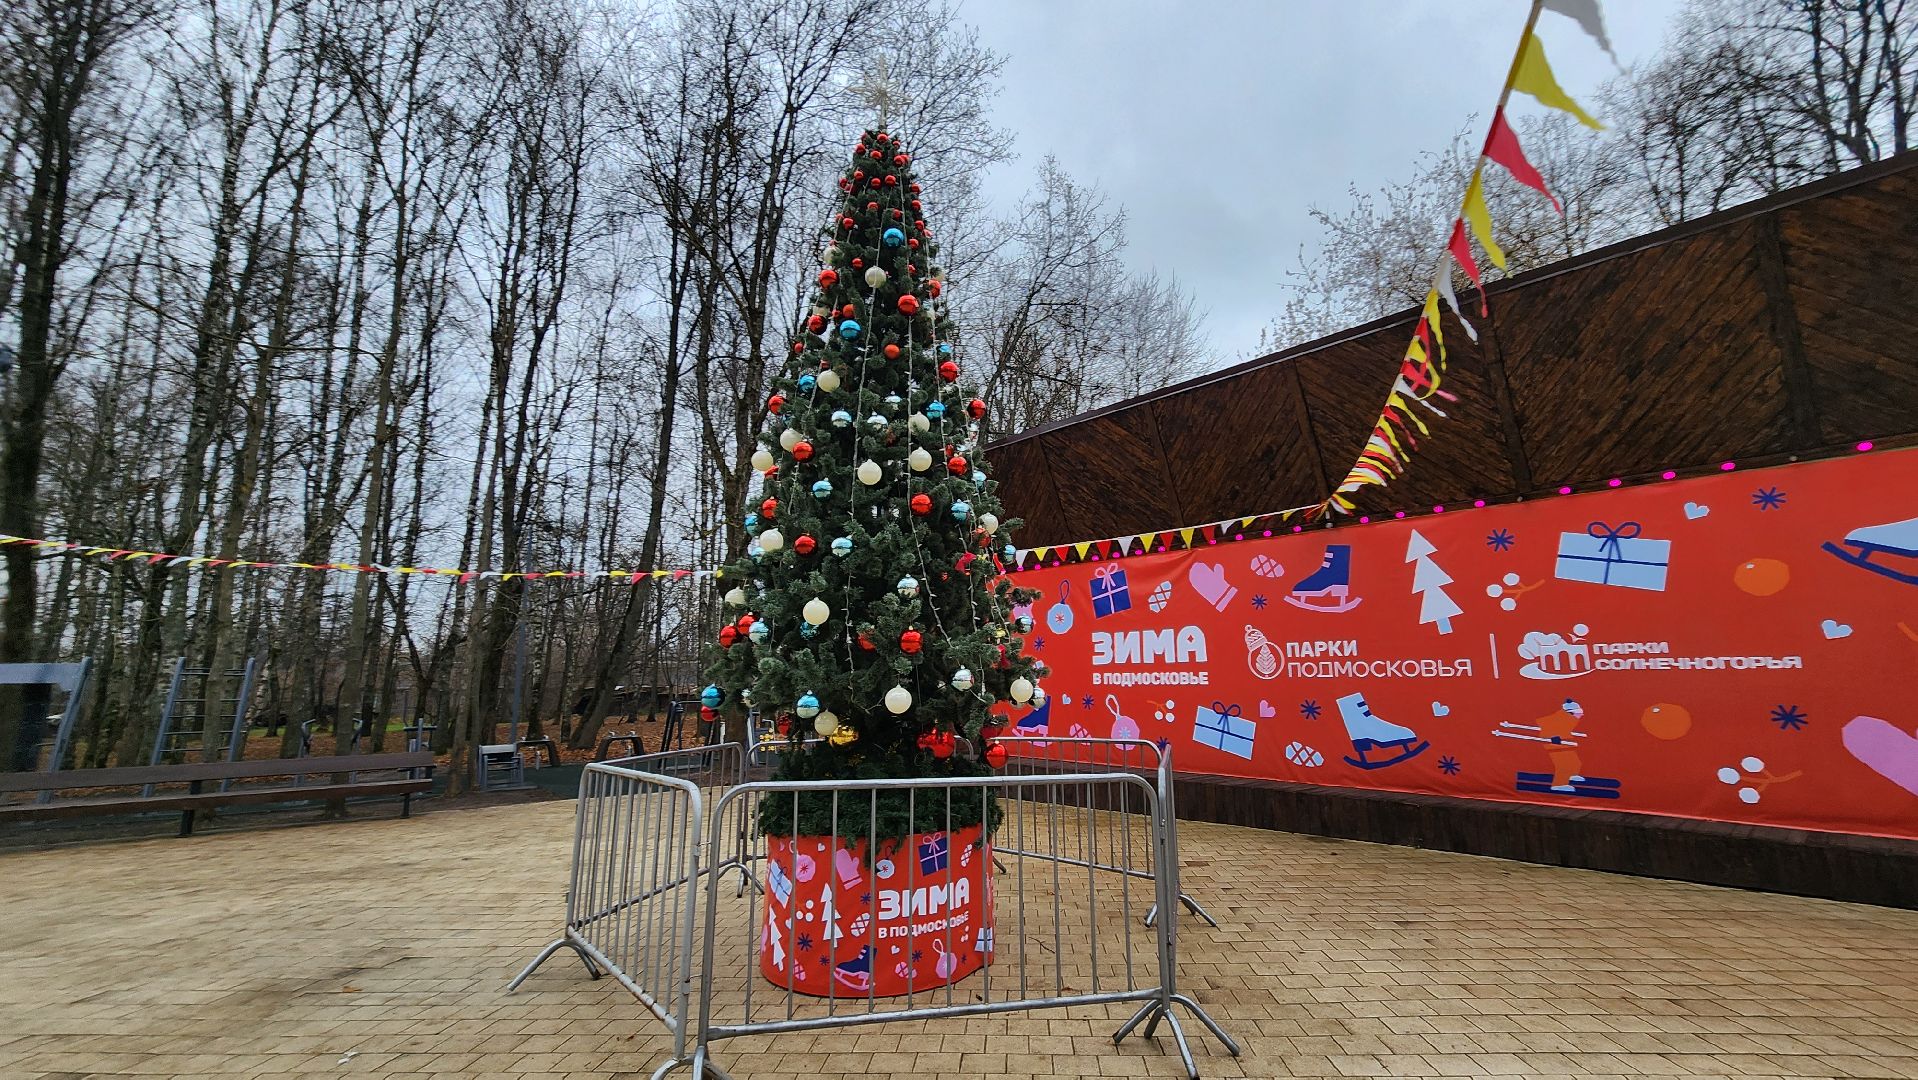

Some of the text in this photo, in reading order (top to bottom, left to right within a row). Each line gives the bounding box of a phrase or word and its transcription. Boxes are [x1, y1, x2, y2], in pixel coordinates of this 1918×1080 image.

[1092, 625, 1208, 665] ЗИМА
[1287, 639, 1358, 658] ПАРКИ
[1593, 641, 1669, 655] ПАРКИ
[1288, 658, 1473, 678] ПОДМОСКОВЬЯ
[1594, 656, 1803, 670] СОЛНЕЧНОГОРЬЯ
[1092, 671, 1209, 687] В ПОДМОСКОВЬЕ
[878, 877, 970, 921] ЗИМА
[878, 927, 888, 939] В
